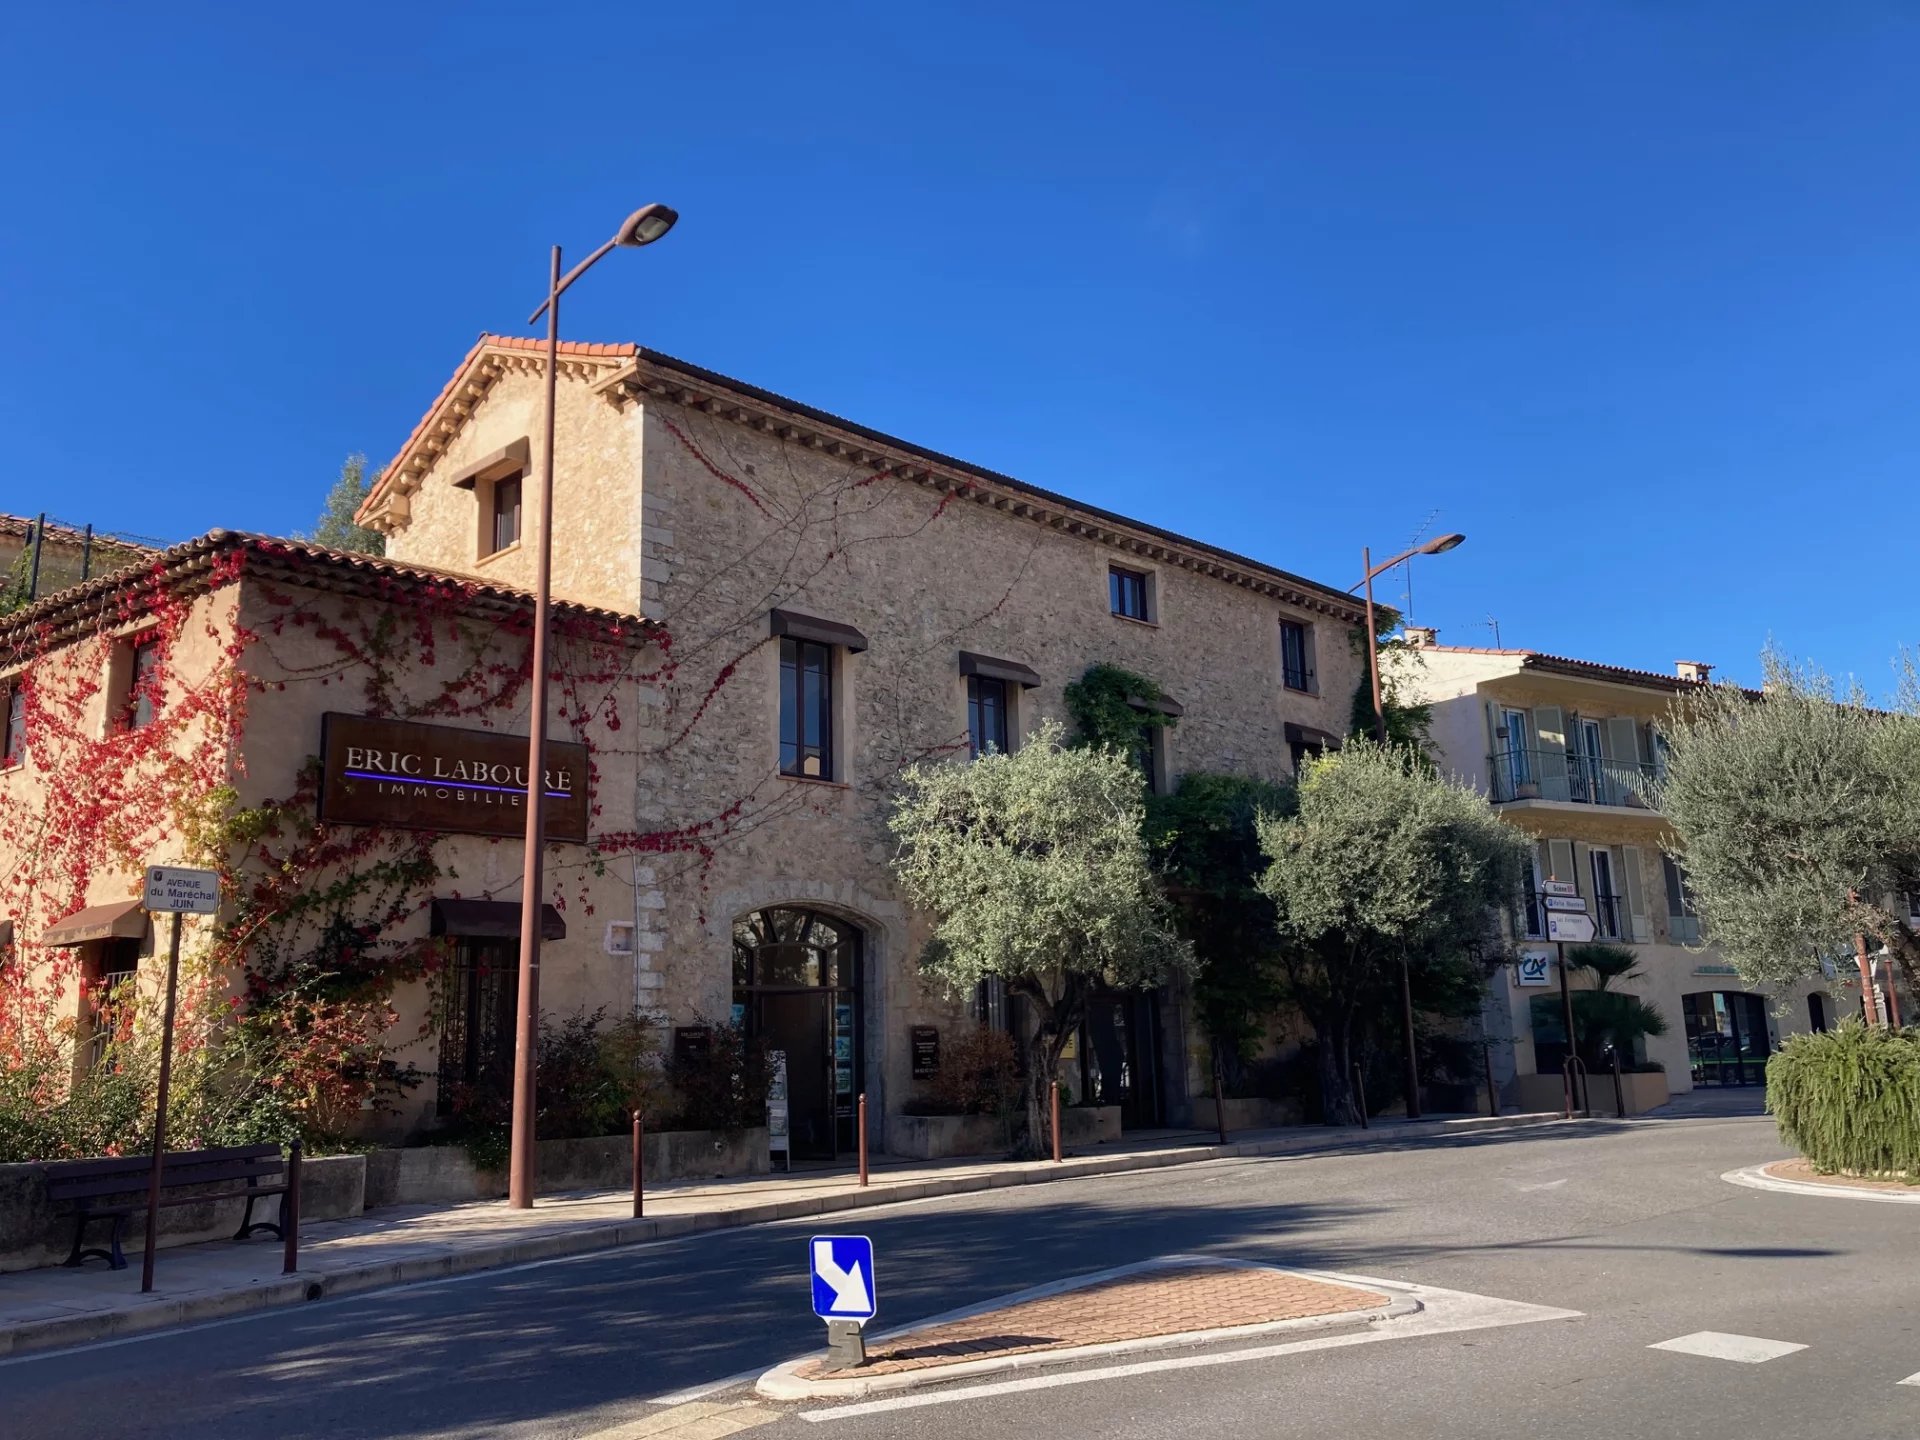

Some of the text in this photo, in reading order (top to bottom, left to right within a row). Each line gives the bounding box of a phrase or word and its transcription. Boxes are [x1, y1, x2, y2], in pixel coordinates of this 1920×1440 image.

[346, 747, 421, 775] ERIC
[378, 782, 520, 806] IMMOBILIE
[167, 879, 201, 889] AVENUE
[150, 888, 215, 900] du Maréchal
[170, 899, 195, 909] JUIN
